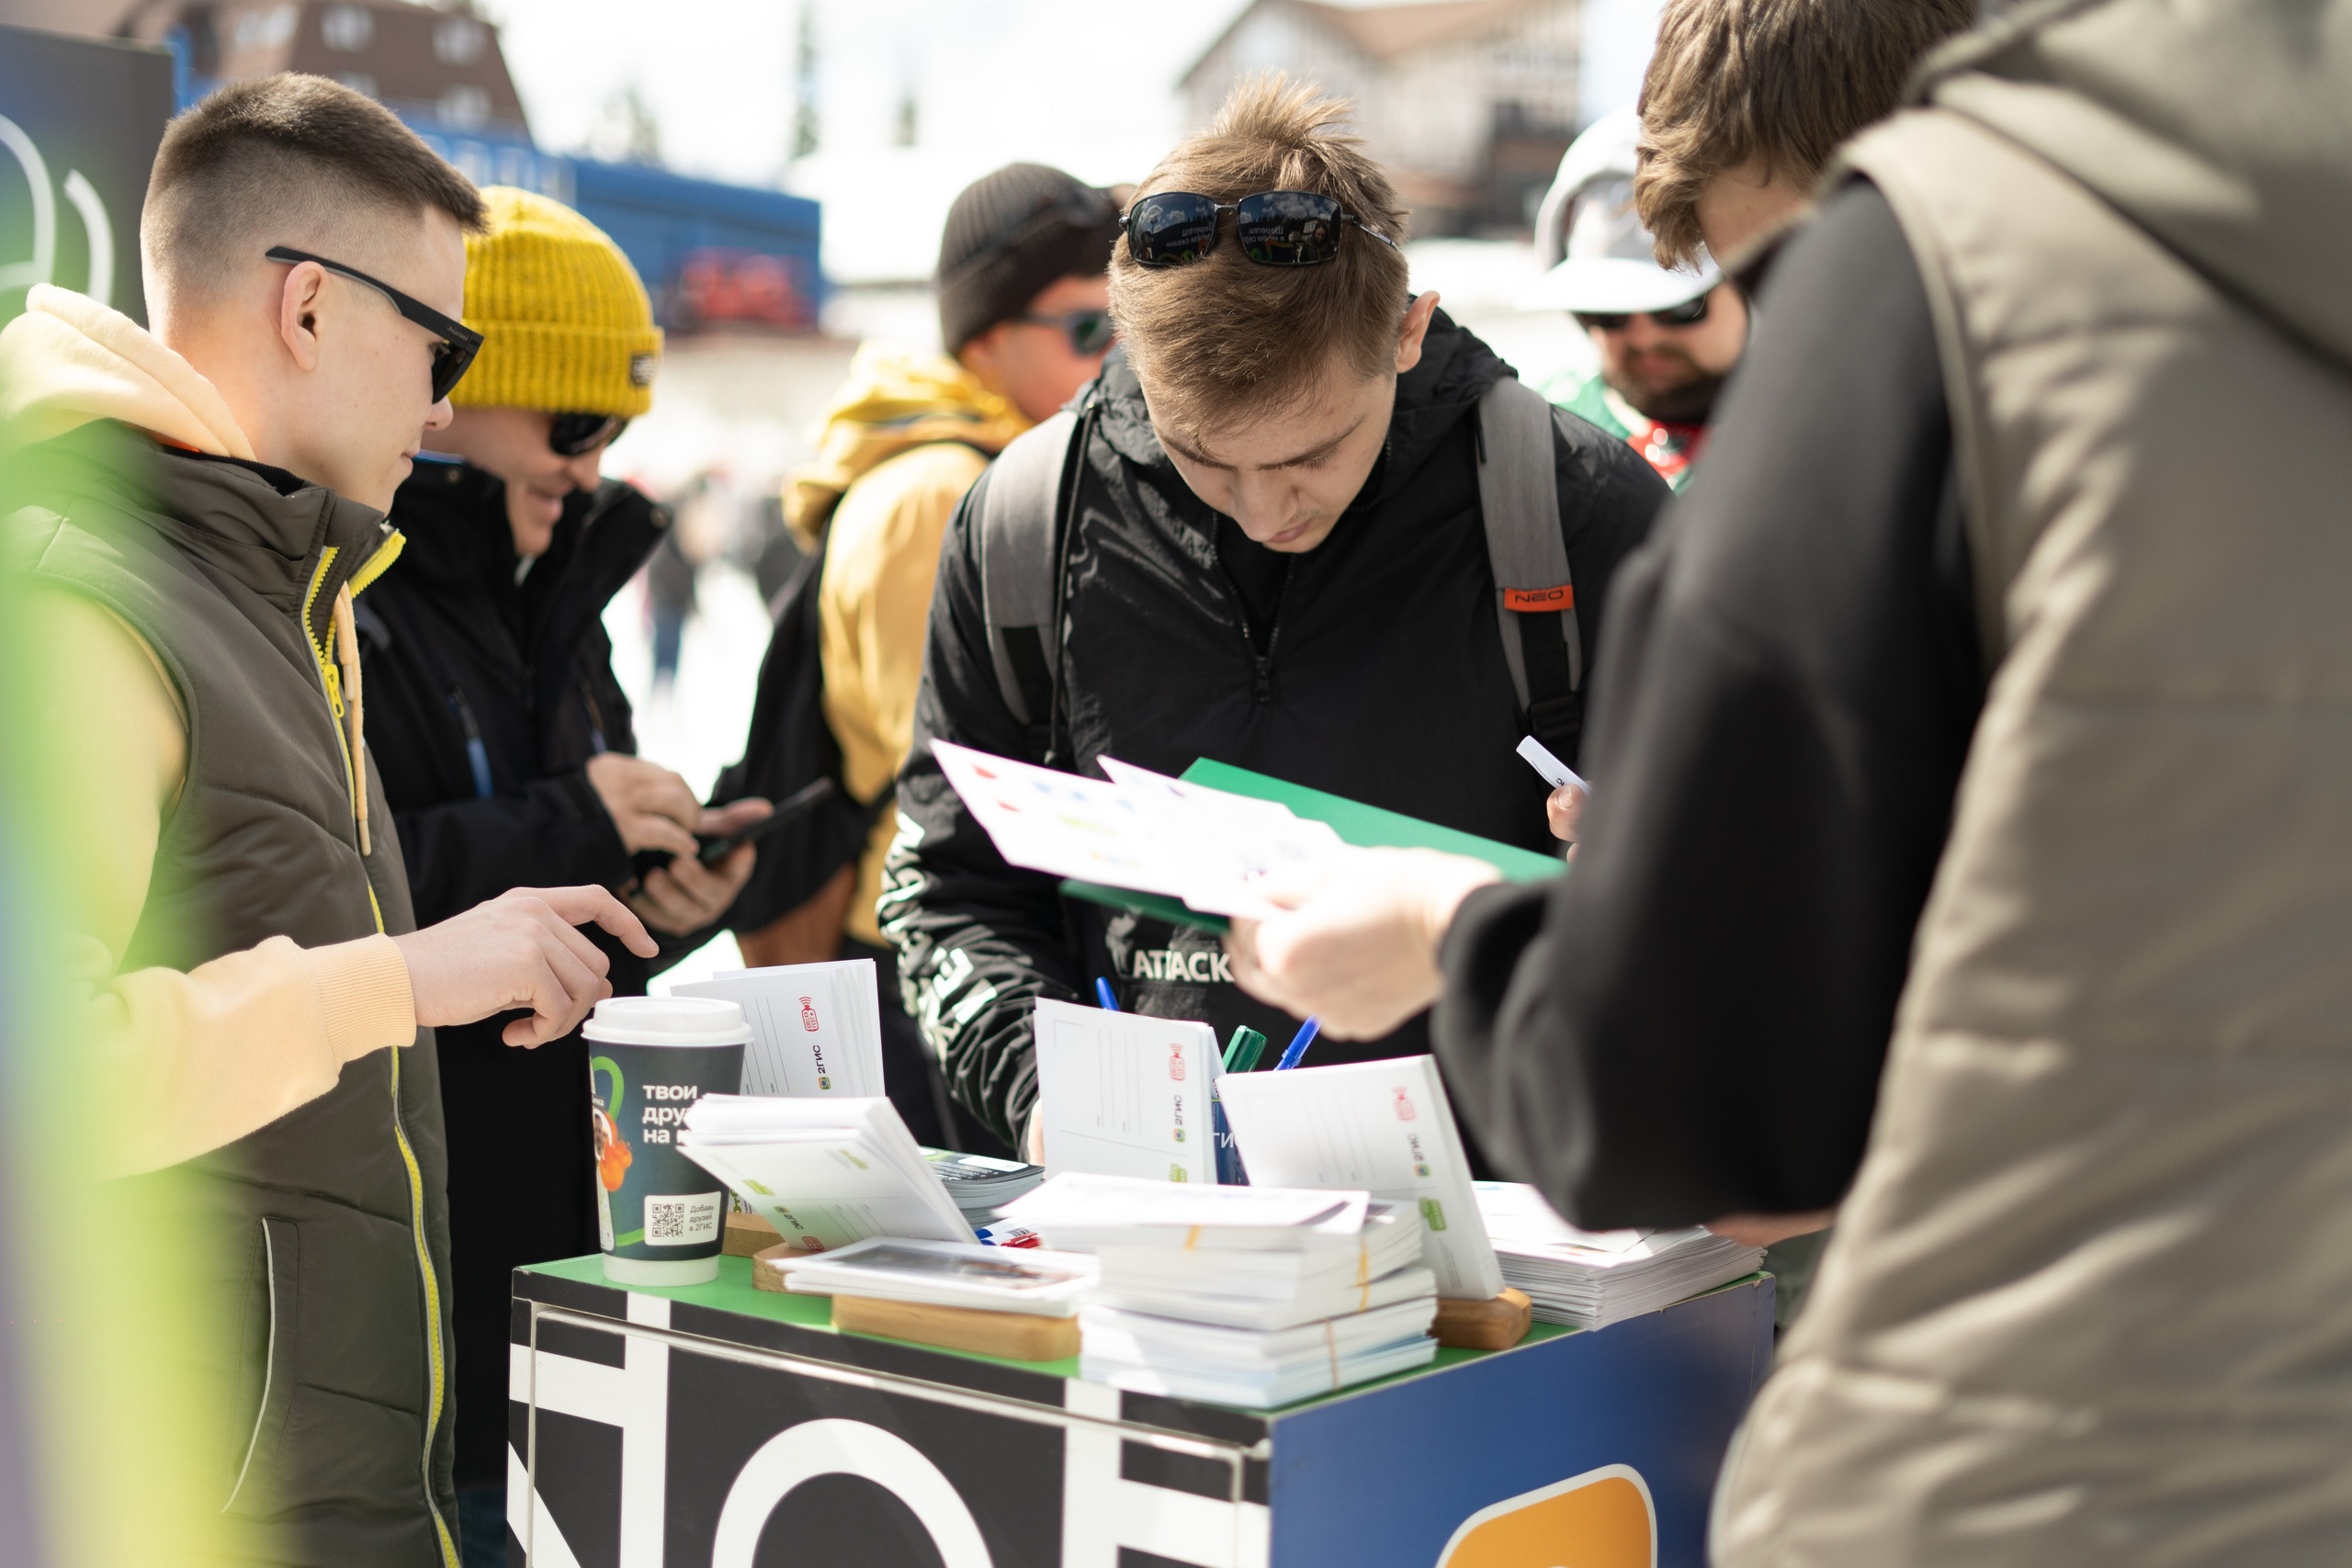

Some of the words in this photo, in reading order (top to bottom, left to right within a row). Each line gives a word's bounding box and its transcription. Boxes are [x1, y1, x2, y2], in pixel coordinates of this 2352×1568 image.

[1515, 590, 1564, 603] NEO
[812, 1044, 826, 1074] 2ГИС
[642, 1107, 690, 1126] дру
[1174, 1095, 1183, 1125] 2ГИС
[643, 1129, 671, 1143] на
[690, 1204, 714, 1213] Добавь
[689, 1213, 712, 1223] друзей
[784, 1213, 804, 1229] 2ГИС
[695, 1223, 712, 1231] 2ГИС
